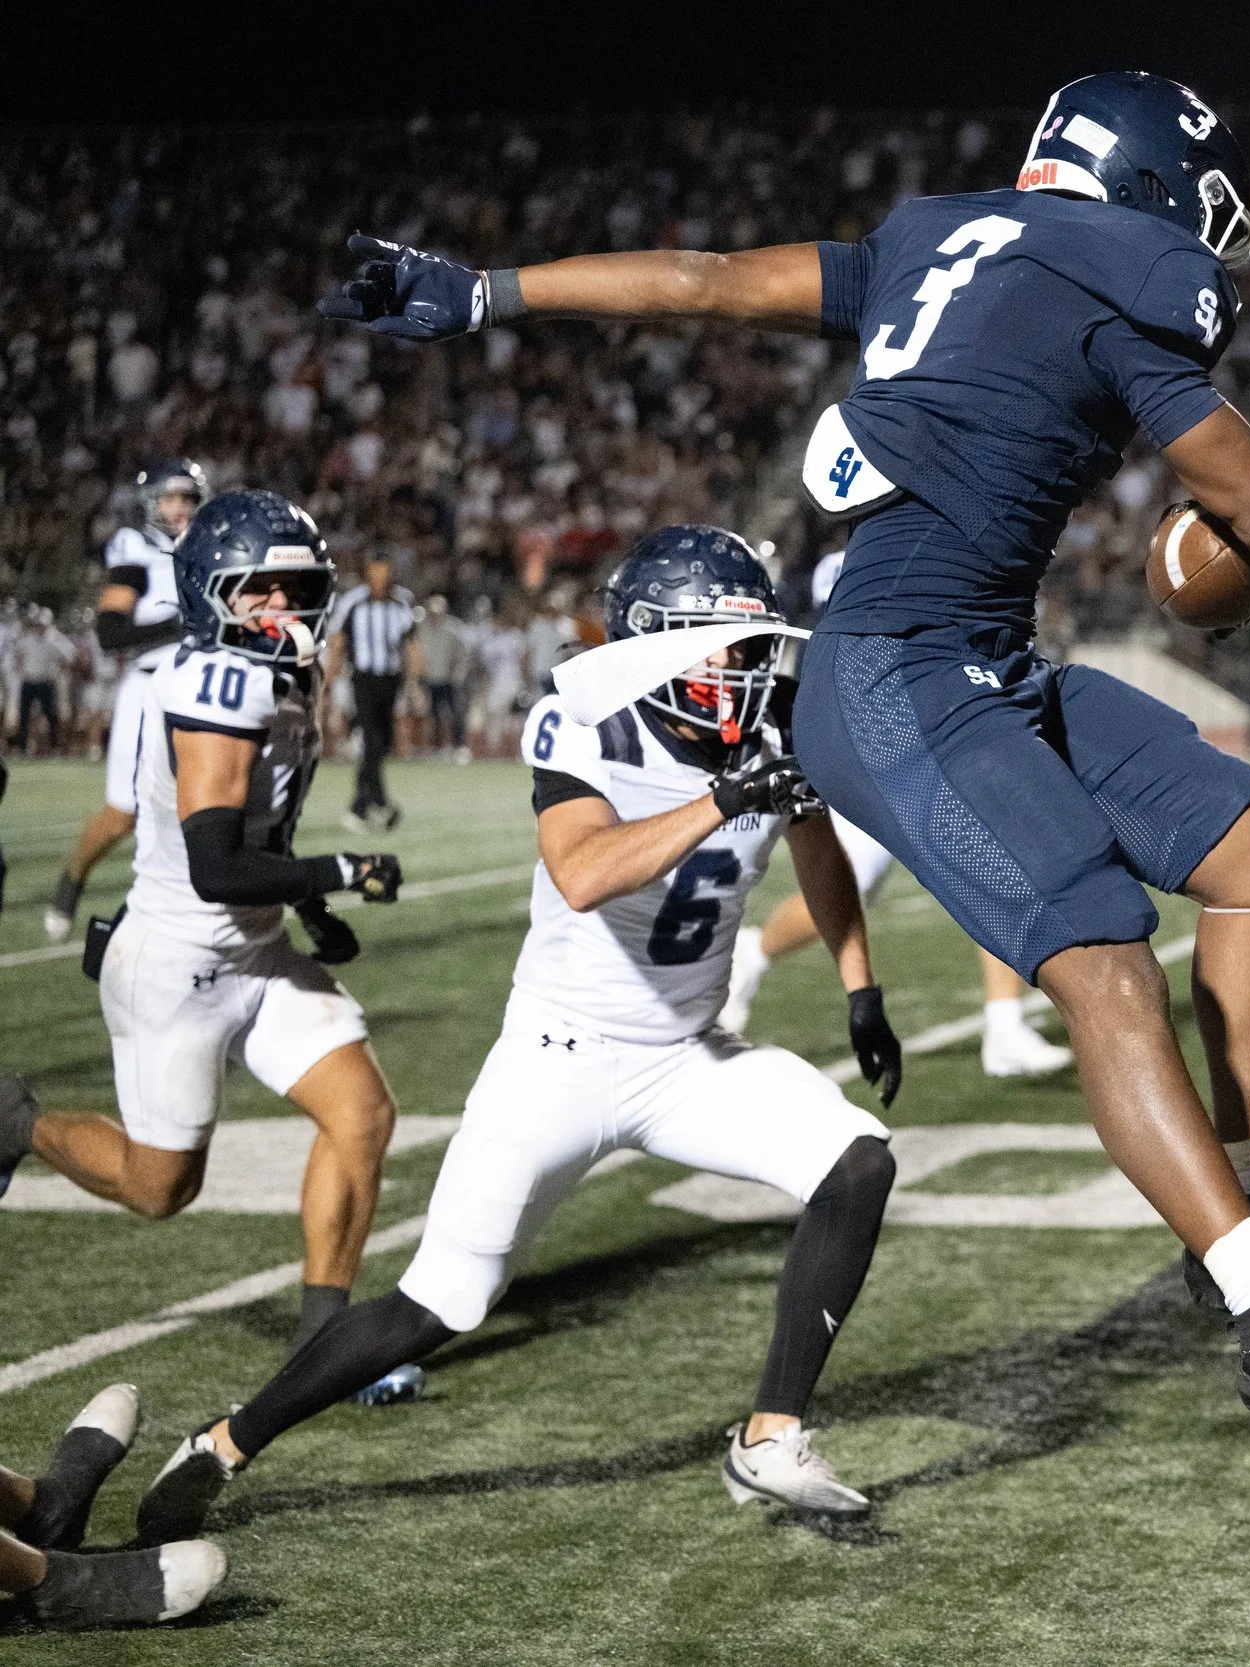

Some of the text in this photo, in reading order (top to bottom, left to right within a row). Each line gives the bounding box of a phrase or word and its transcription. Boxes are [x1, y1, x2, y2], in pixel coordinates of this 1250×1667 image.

[1178, 99, 1218, 141] 3
[1016, 163, 1058, 190] dell
[864, 214, 1027, 380] 3
[829, 446, 863, 498] SV
[725, 599, 762, 611] Riddell
[196, 663, 247, 711] 10
[533, 709, 562, 763] 6
[717, 812, 760, 831] PION
[647, 846, 741, 966] 6
